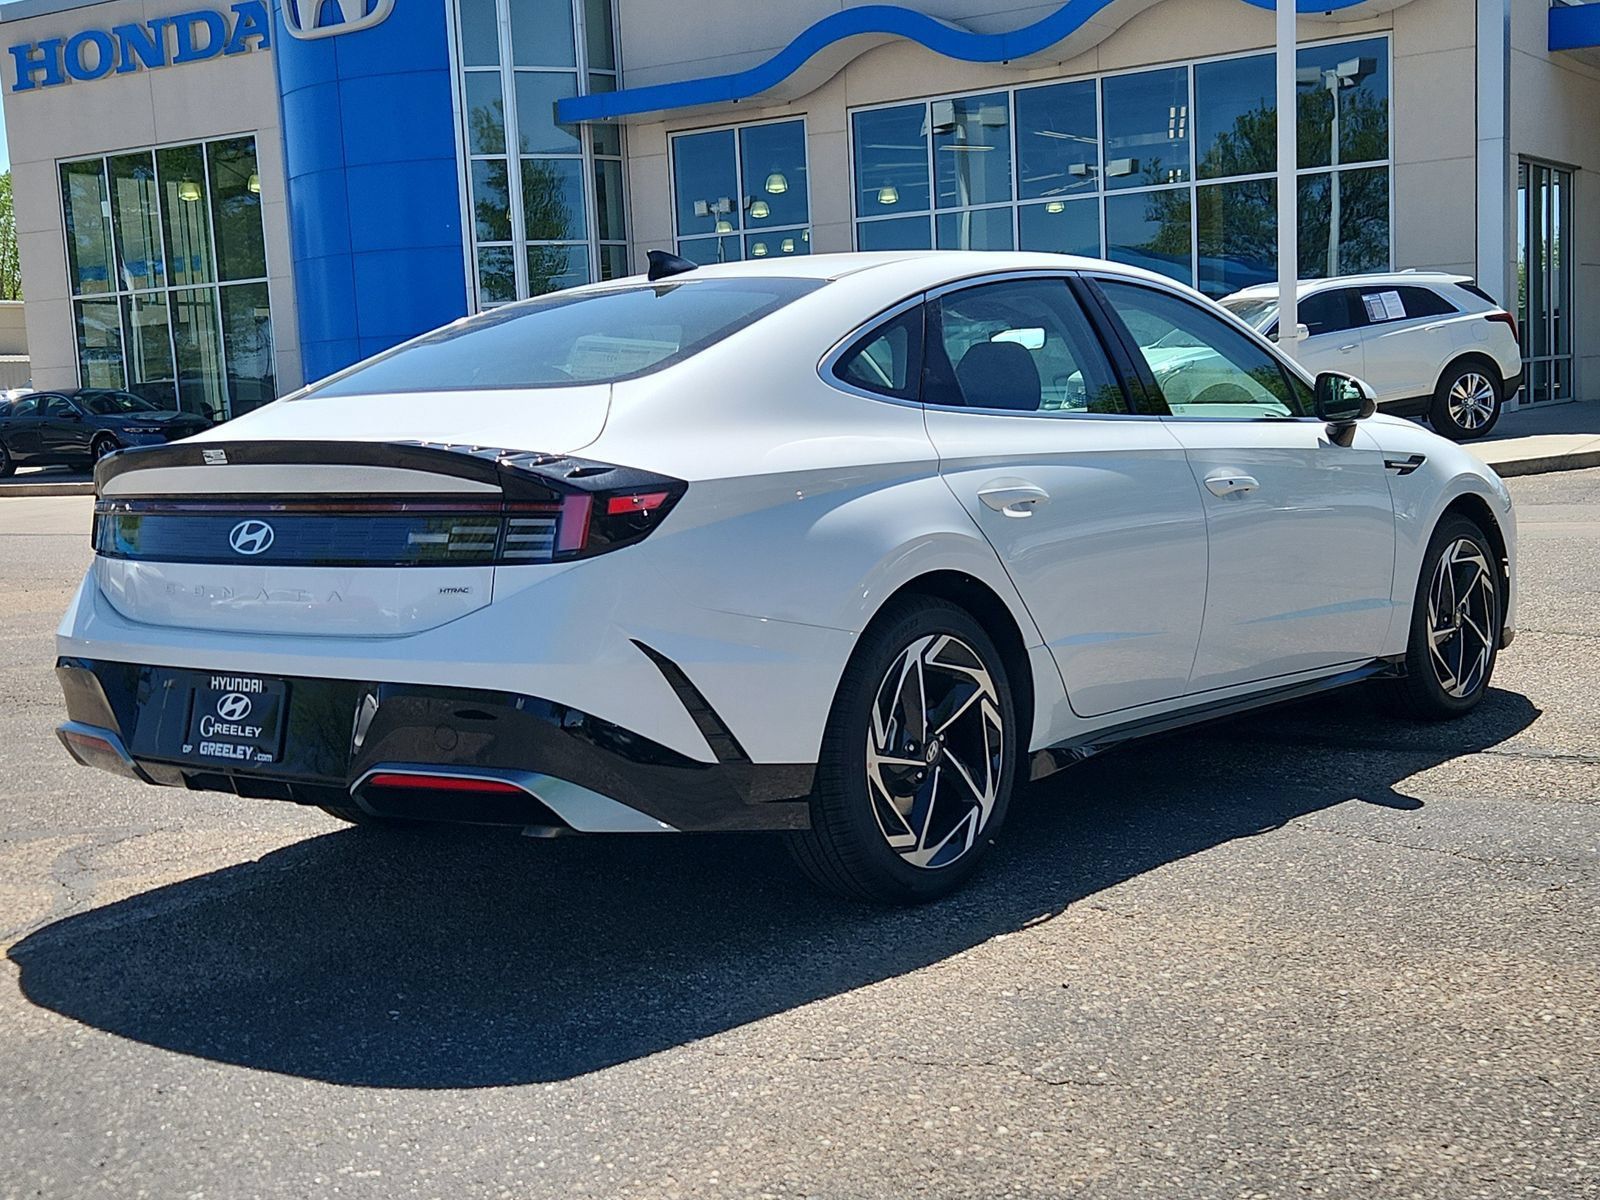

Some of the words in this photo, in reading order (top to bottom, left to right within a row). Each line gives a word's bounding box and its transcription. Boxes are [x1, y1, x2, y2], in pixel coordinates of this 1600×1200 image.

[8, 0, 271, 93] HONDA
[438, 585, 470, 595] HTRAC
[211, 676, 263, 693] HYUNDAI
[200, 715, 262, 738] GREELEY
